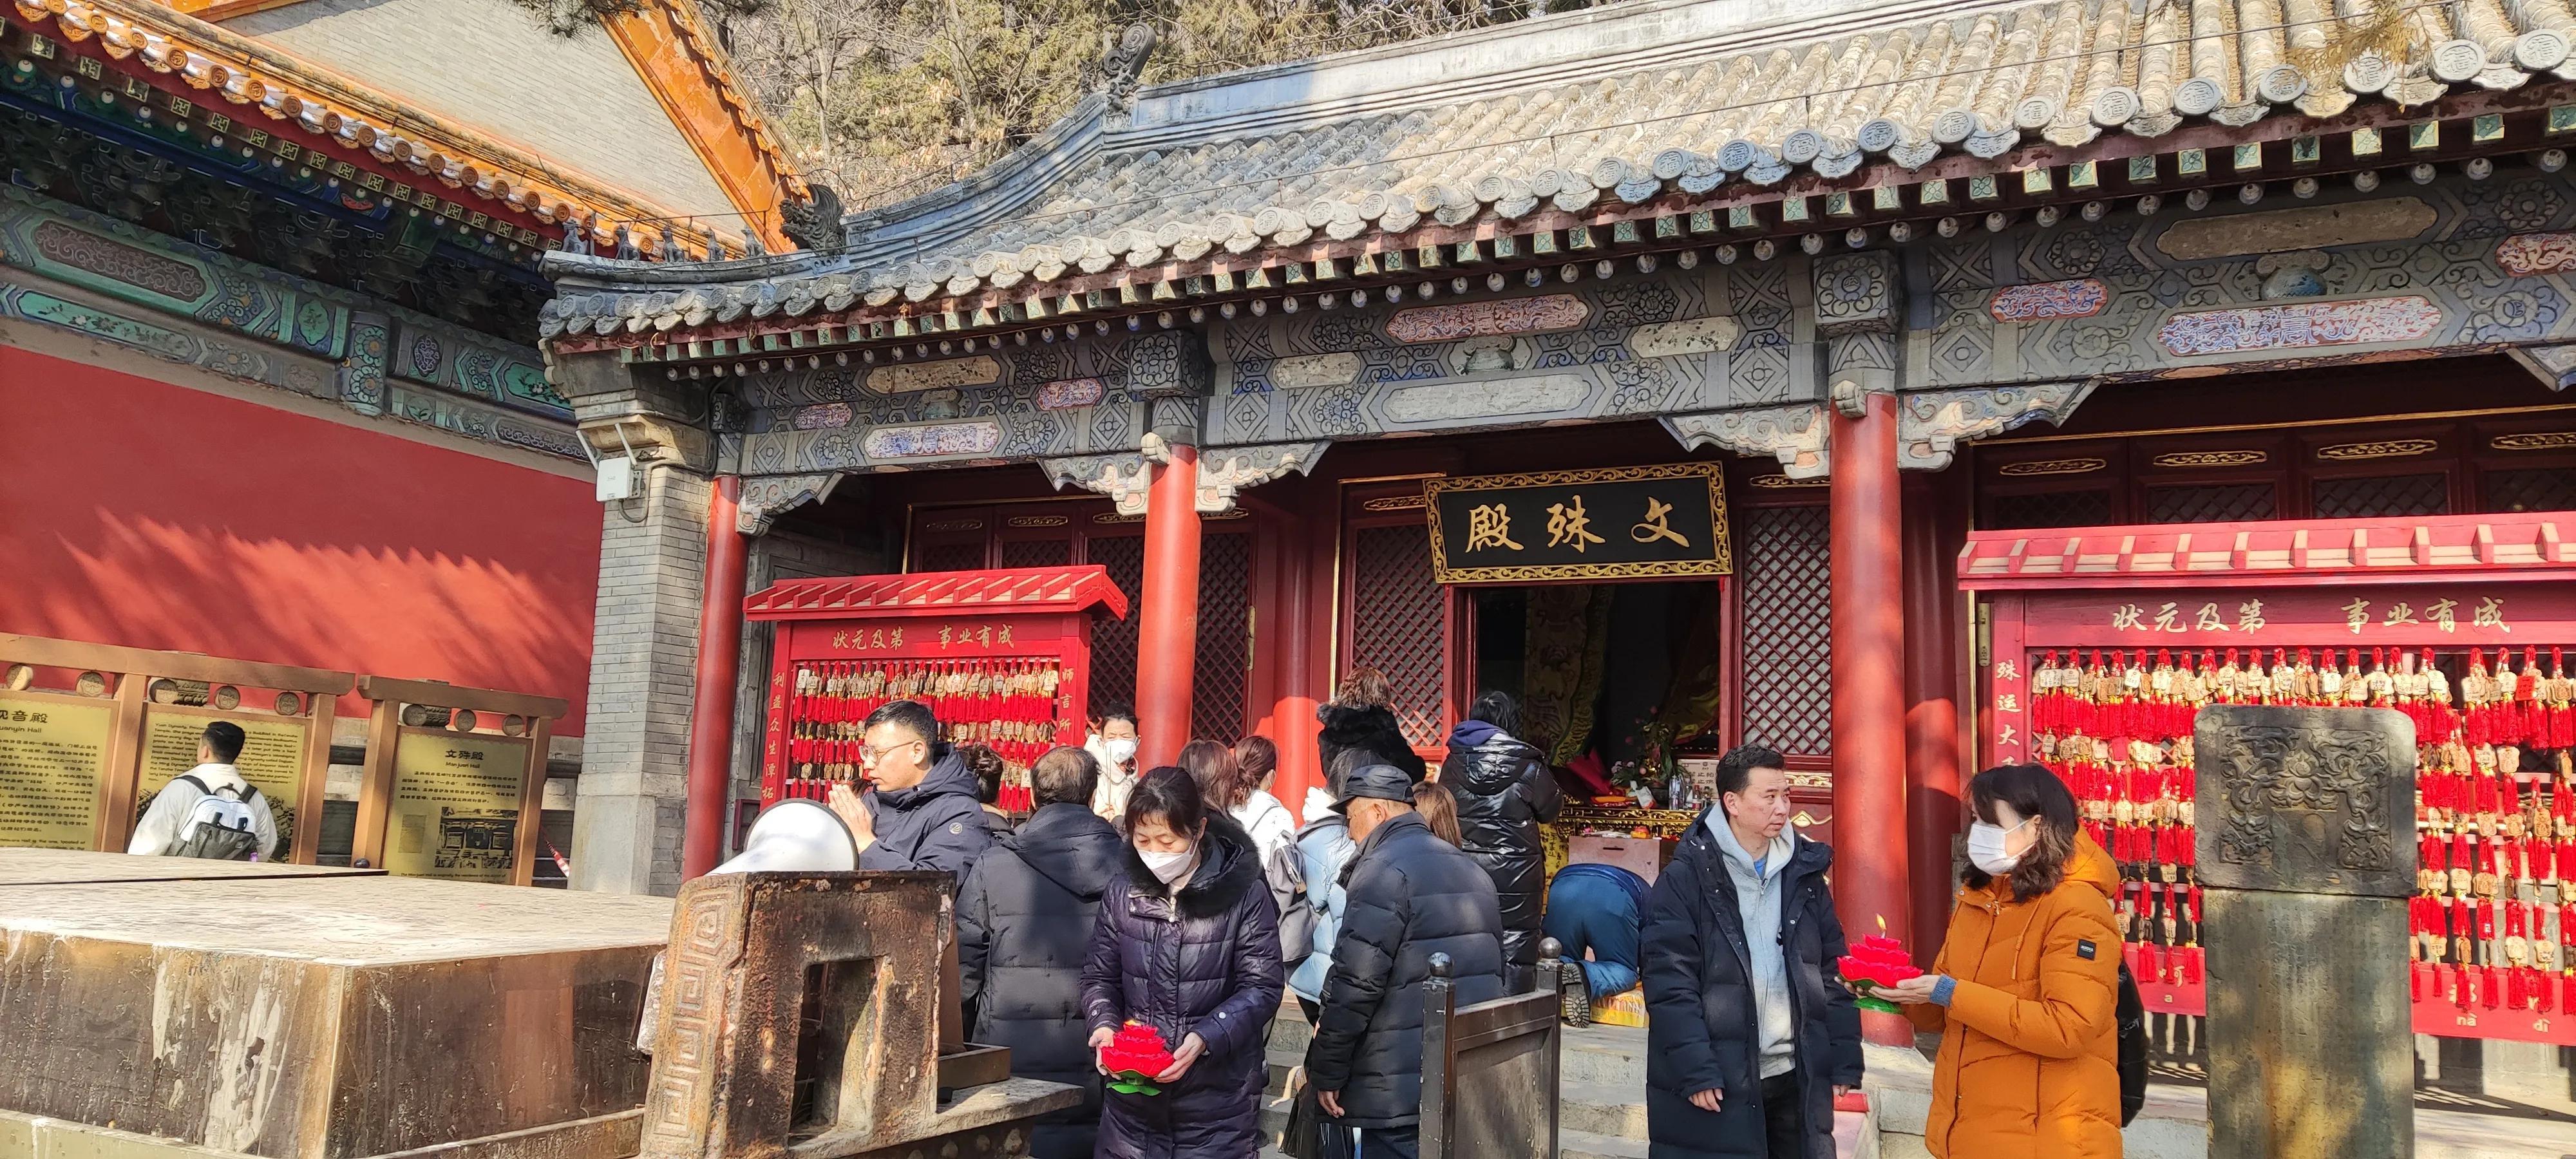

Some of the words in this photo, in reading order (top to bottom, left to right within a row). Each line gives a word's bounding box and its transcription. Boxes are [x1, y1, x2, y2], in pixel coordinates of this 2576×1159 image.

[1464, 495, 1690, 553] 文殊殿
[2112, 601, 2267, 635] 状元及第
[2340, 597, 2512, 634] 事业有成
[833, 627, 904, 651] 状元及第
[938, 624, 1015, 650] 事业有成
[1058, 668, 1075, 746] 师言所
[445, 749, 484, 760] 文殊殿
